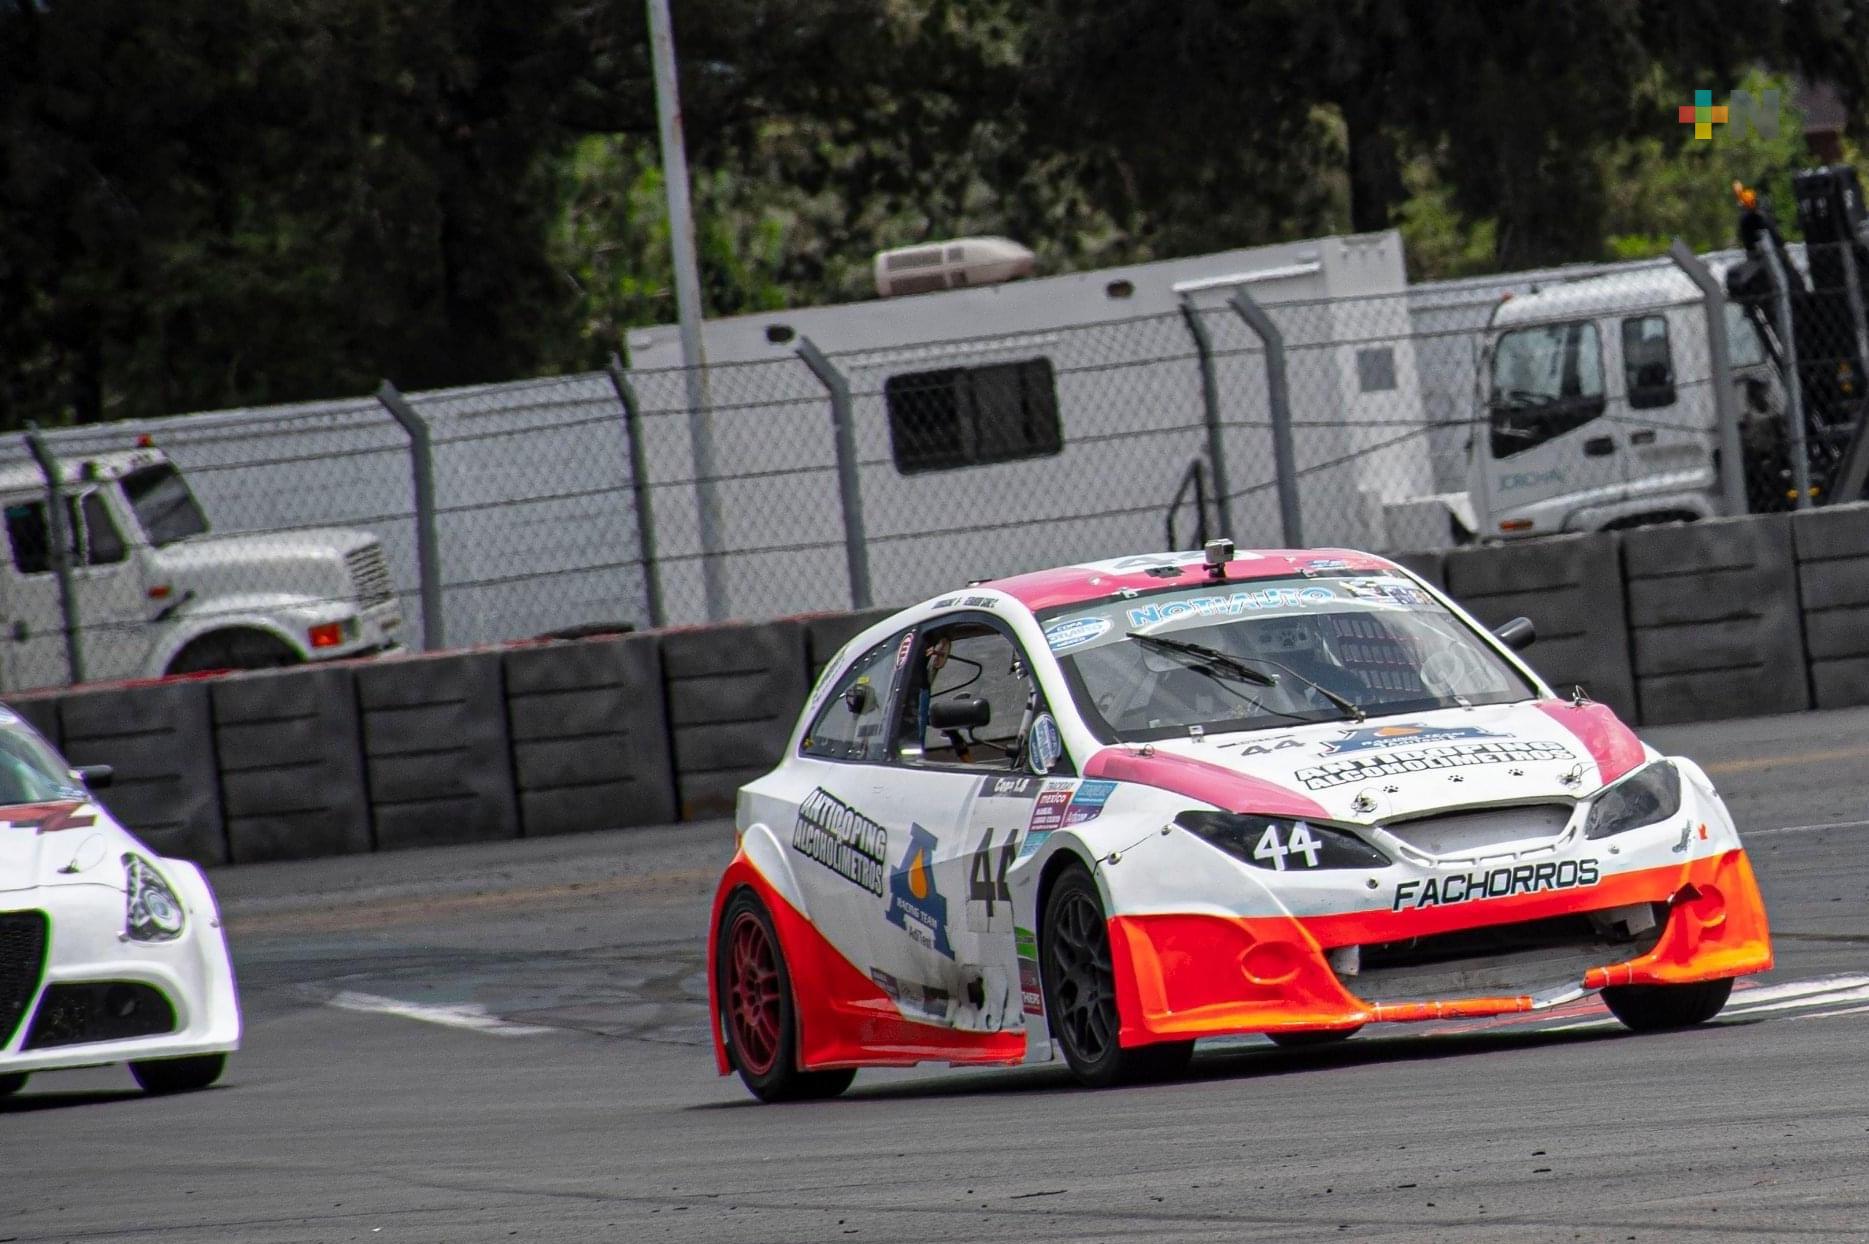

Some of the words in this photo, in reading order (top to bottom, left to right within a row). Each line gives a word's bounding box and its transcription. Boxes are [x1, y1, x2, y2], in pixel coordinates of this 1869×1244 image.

[1241, 739, 1306, 757] 44
[1294, 741, 1566, 781] ANTIDOPING
[1305, 750, 1577, 790] ALCOHOLIMETROS
[798, 786, 888, 865] ANTIDOPING
[1254, 820, 1323, 872] 44
[792, 815, 884, 898] ALCOHOLIMETROS
[1392, 858, 1600, 912] FACHORROS
